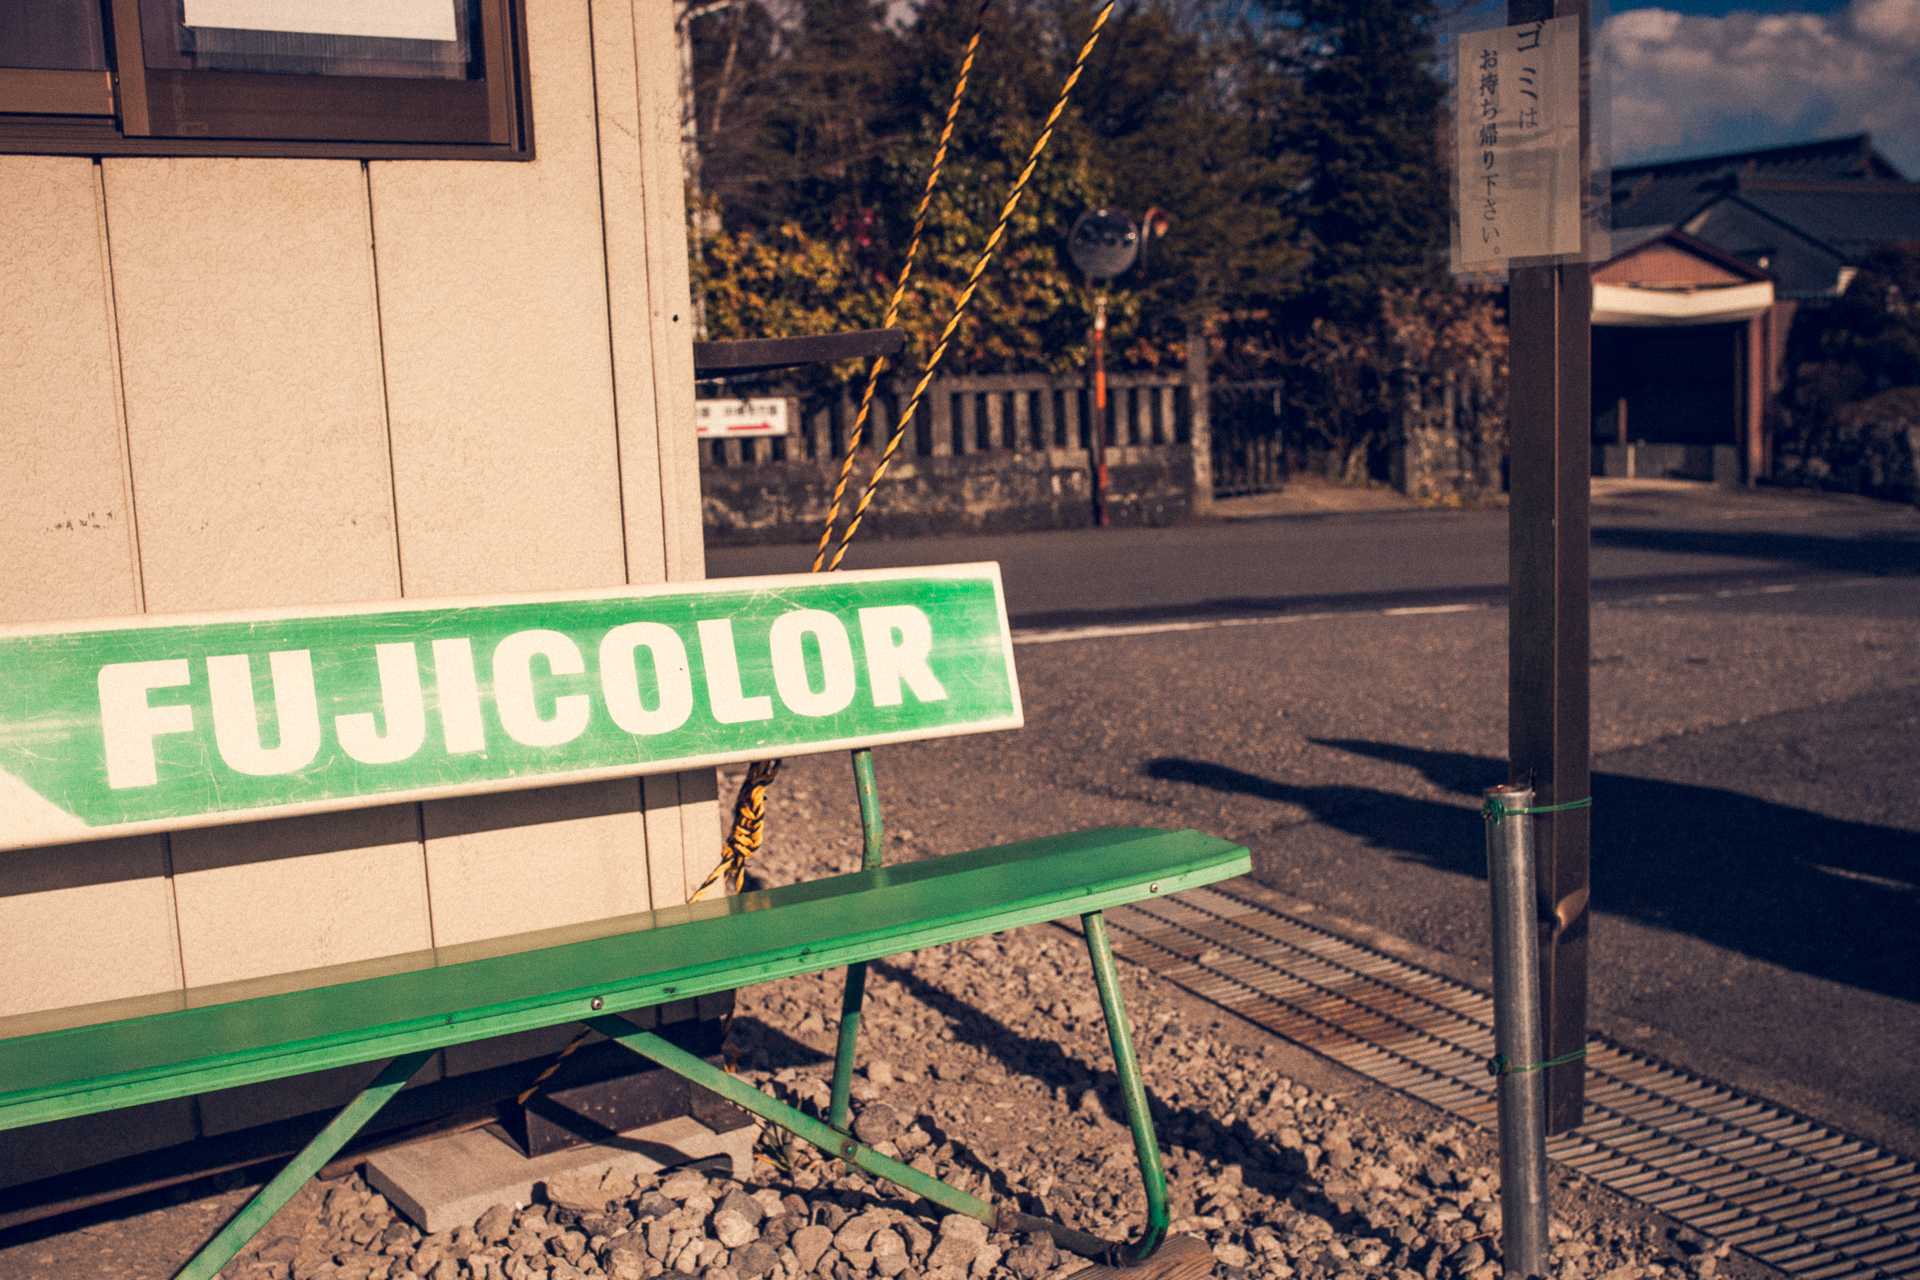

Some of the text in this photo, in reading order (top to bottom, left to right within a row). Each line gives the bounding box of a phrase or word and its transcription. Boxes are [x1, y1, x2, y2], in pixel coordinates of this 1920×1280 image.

[1480, 49, 1502, 254] お持ち帰り下さい。
[1517, 19, 1546, 128] ゴミは
[97, 604, 948, 789] FUJICOLOR
